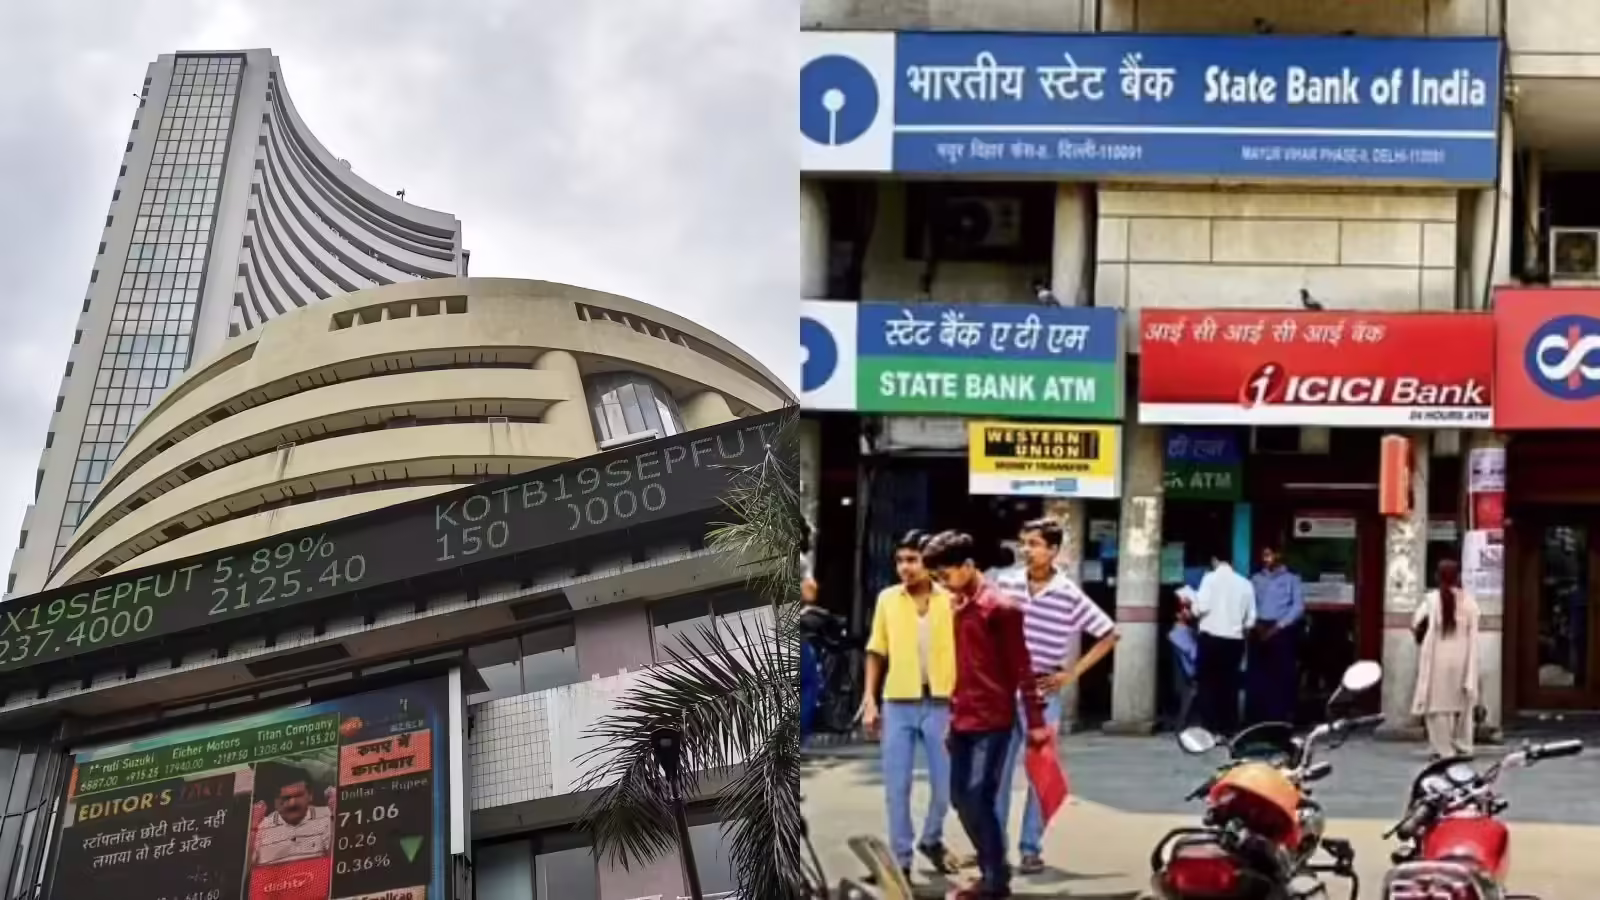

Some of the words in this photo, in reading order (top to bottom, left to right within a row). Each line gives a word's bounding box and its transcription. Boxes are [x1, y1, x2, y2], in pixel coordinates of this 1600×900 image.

[906, 51, 1025, 101] भारतीय
[1036, 53, 1106, 101] स्टेट
[1119, 52, 1176, 102] बैंक
[1204, 65, 1277, 103] State
[1286, 66, 1361, 105] Bank
[1370, 68, 1403, 105] of
[1412, 67, 1487, 106] India
[885, 310, 934, 347] स्टेट
[940, 310, 985, 348] बैंक
[990, 322, 1013, 351] ए
[1014, 314, 1043, 350] टी
[1047, 324, 1090, 353] एम
[1145, 318, 1185, 345] आई
[1193, 317, 1218, 343] सी
[1223, 318, 1263, 345] आई
[1272, 318, 1297, 343] सी
[1303, 319, 1345, 346] आई
[879, 371, 958, 397] STATE
[965, 373, 1035, 400] BANK
[1043, 376, 1096, 403] ATM
[1284, 375, 1388, 404] ICICI
[1391, 377, 1486, 405] Bank
[1466, 410, 1489, 421] ATM
[986, 430, 1080, 443] WESTERN
[1015, 445, 1080, 457] UNION
[435, 421, 776, 530] KOTB19SEPFUT
[1190, 471, 1233, 489] ATM
[436, 520, 510, 562] 150
[0, 564, 202, 637] X19SEPFUT
[213, 533, 335, 584] 5.89%
[208, 554, 367, 616] 2125.40
[257, 730, 283, 742] Titan
[285, 720, 334, 737] Company
[122, 753, 155, 769] Suzuki
[172, 747, 202, 760] Eicher
[206, 738, 241, 753] Motors
[341, 786, 375, 801] Dollar
[391, 778, 428, 792] Rupee
[78, 788, 173, 822] EDITOR'S
[338, 803, 399, 828] 71.06
[82, 828, 136, 850] स्टॉपलॉस
[140, 820, 168, 839] छोटी
[204, 809, 228, 828] नहीं
[338, 832, 377, 850] 0.26
[93, 850, 131, 868] लगाया
[136, 844, 149, 861] तो
[153, 838, 176, 858] हार्ट
[179, 834, 213, 854] अटैक
[336, 852, 391, 875] 0.36%
